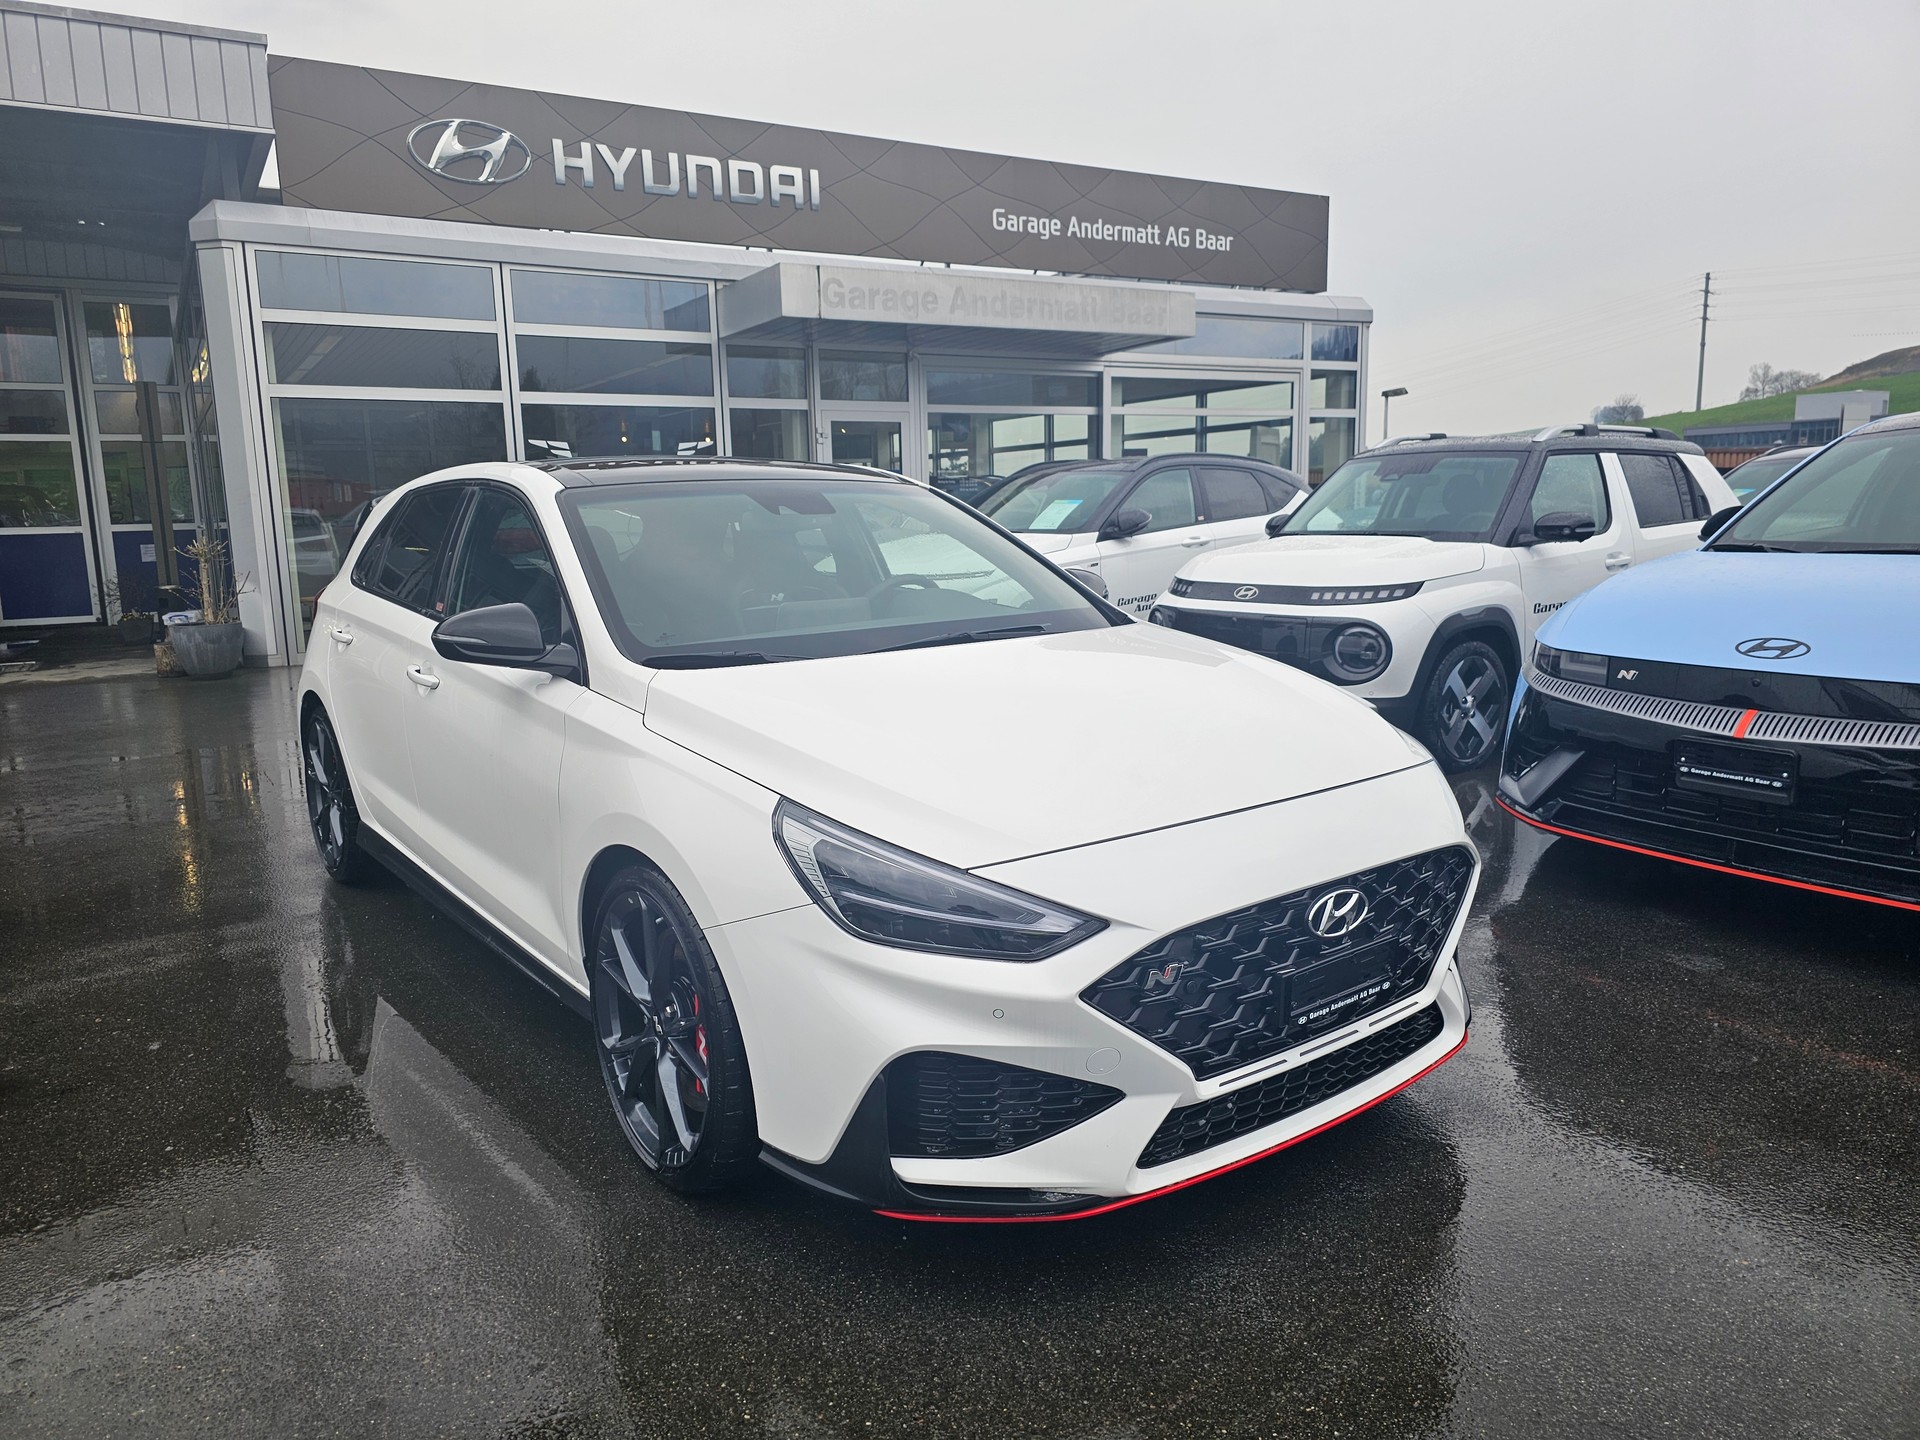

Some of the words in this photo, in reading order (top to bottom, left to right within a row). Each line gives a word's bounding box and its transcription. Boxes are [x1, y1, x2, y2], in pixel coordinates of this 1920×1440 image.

[552, 138, 821, 211] HYUNDAI
[992, 208, 1061, 240] Garage
[1067, 216, 1161, 246] Andermatt
[1165, 226, 1190, 248] AG
[1195, 229, 1234, 252] Baar
[822, 277, 939, 317] Garage
[950, 285, 1099, 323] Andermatt
[1117, 594, 1157, 606] Garage
[1534, 601, 1567, 614] Gara
[1712, 772, 1743, 781] Andermatt
[1309, 1007, 1329, 1019] Garage
[1330, 995, 1359, 1011] Andermatt
[1369, 986, 1381, 995] Baar
